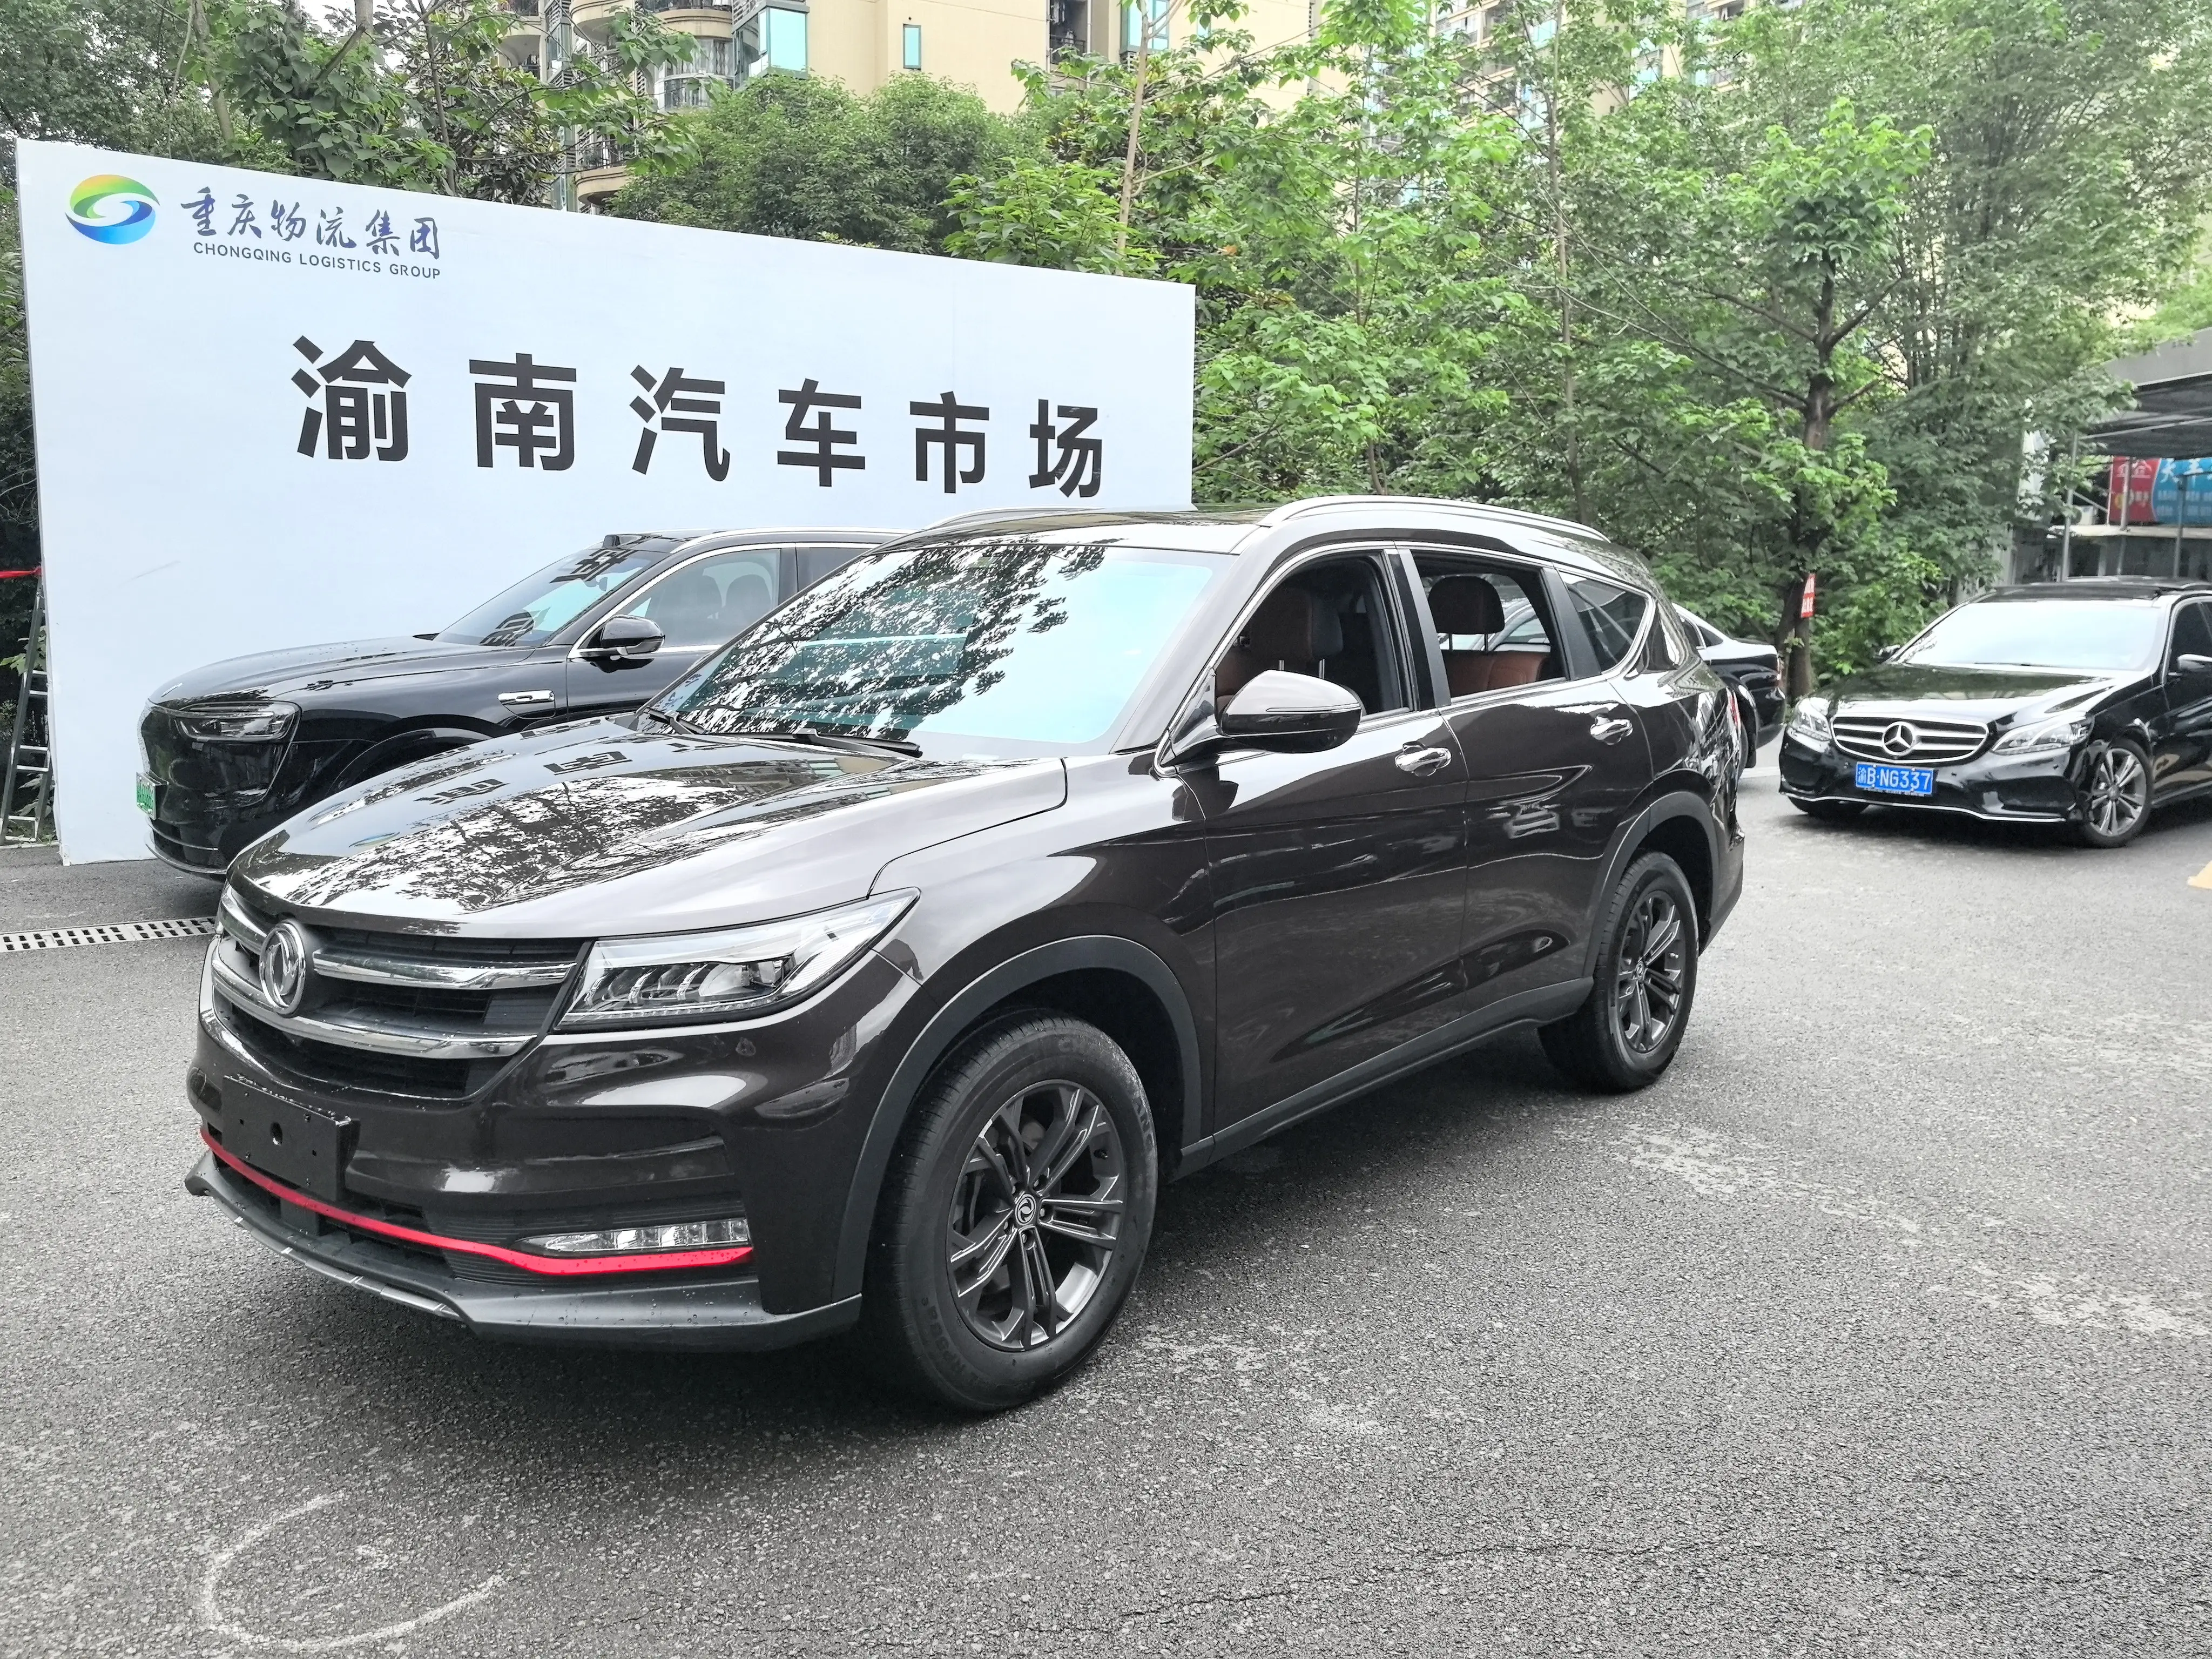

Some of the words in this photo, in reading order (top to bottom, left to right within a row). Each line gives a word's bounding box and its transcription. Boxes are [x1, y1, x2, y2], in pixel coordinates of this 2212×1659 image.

[181, 186, 440, 260] 重庆物流集团
[193, 242, 292, 263] CHONGQING
[300, 253, 381, 273] LOGISTICS
[389, 264, 440, 279] GROUP
[291, 335, 1103, 498] 渝南汽车市场
